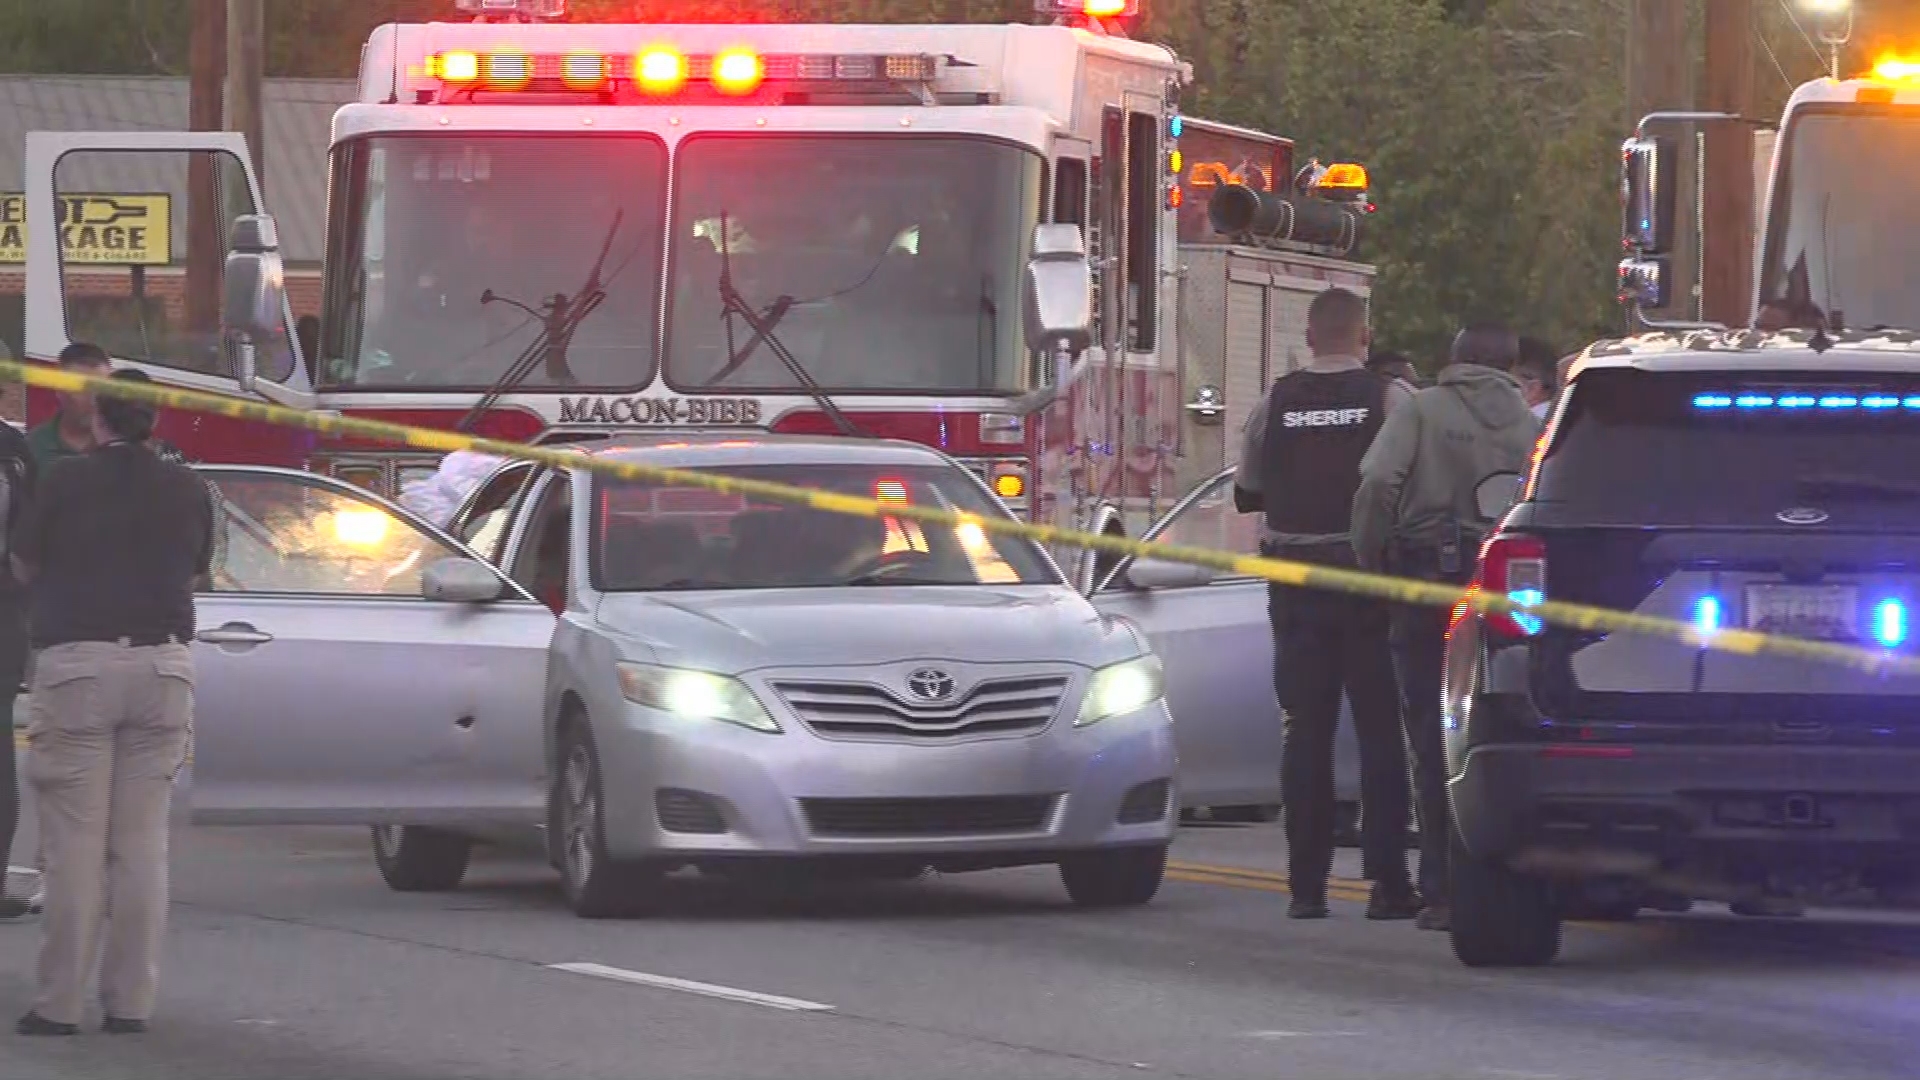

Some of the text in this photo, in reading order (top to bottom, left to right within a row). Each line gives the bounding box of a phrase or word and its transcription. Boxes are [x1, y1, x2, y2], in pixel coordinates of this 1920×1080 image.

[1, 225, 147, 249] AKAGE
[558, 397, 761, 423] MACON-BIBB
[1282, 407, 1370, 428] SHERIFF
